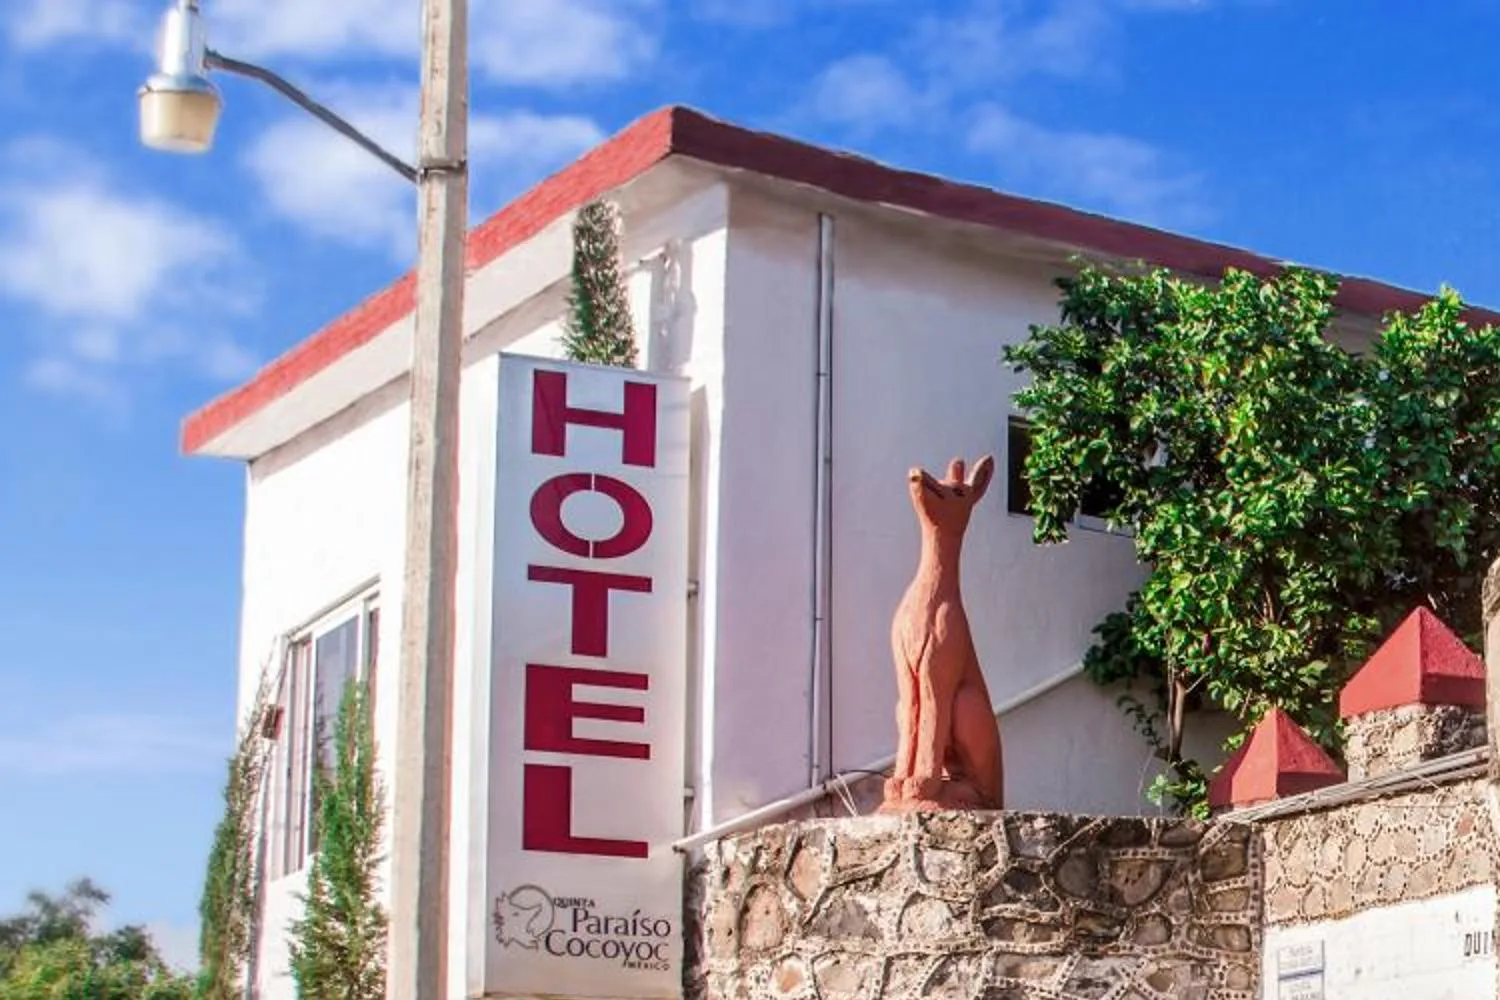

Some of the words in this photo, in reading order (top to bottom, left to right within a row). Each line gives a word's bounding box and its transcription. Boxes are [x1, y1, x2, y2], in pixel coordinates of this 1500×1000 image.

[523, 369, 657, 858] HOTEL
[553, 896, 596, 909] QUINTA
[572, 908, 671, 938] Paraíso
